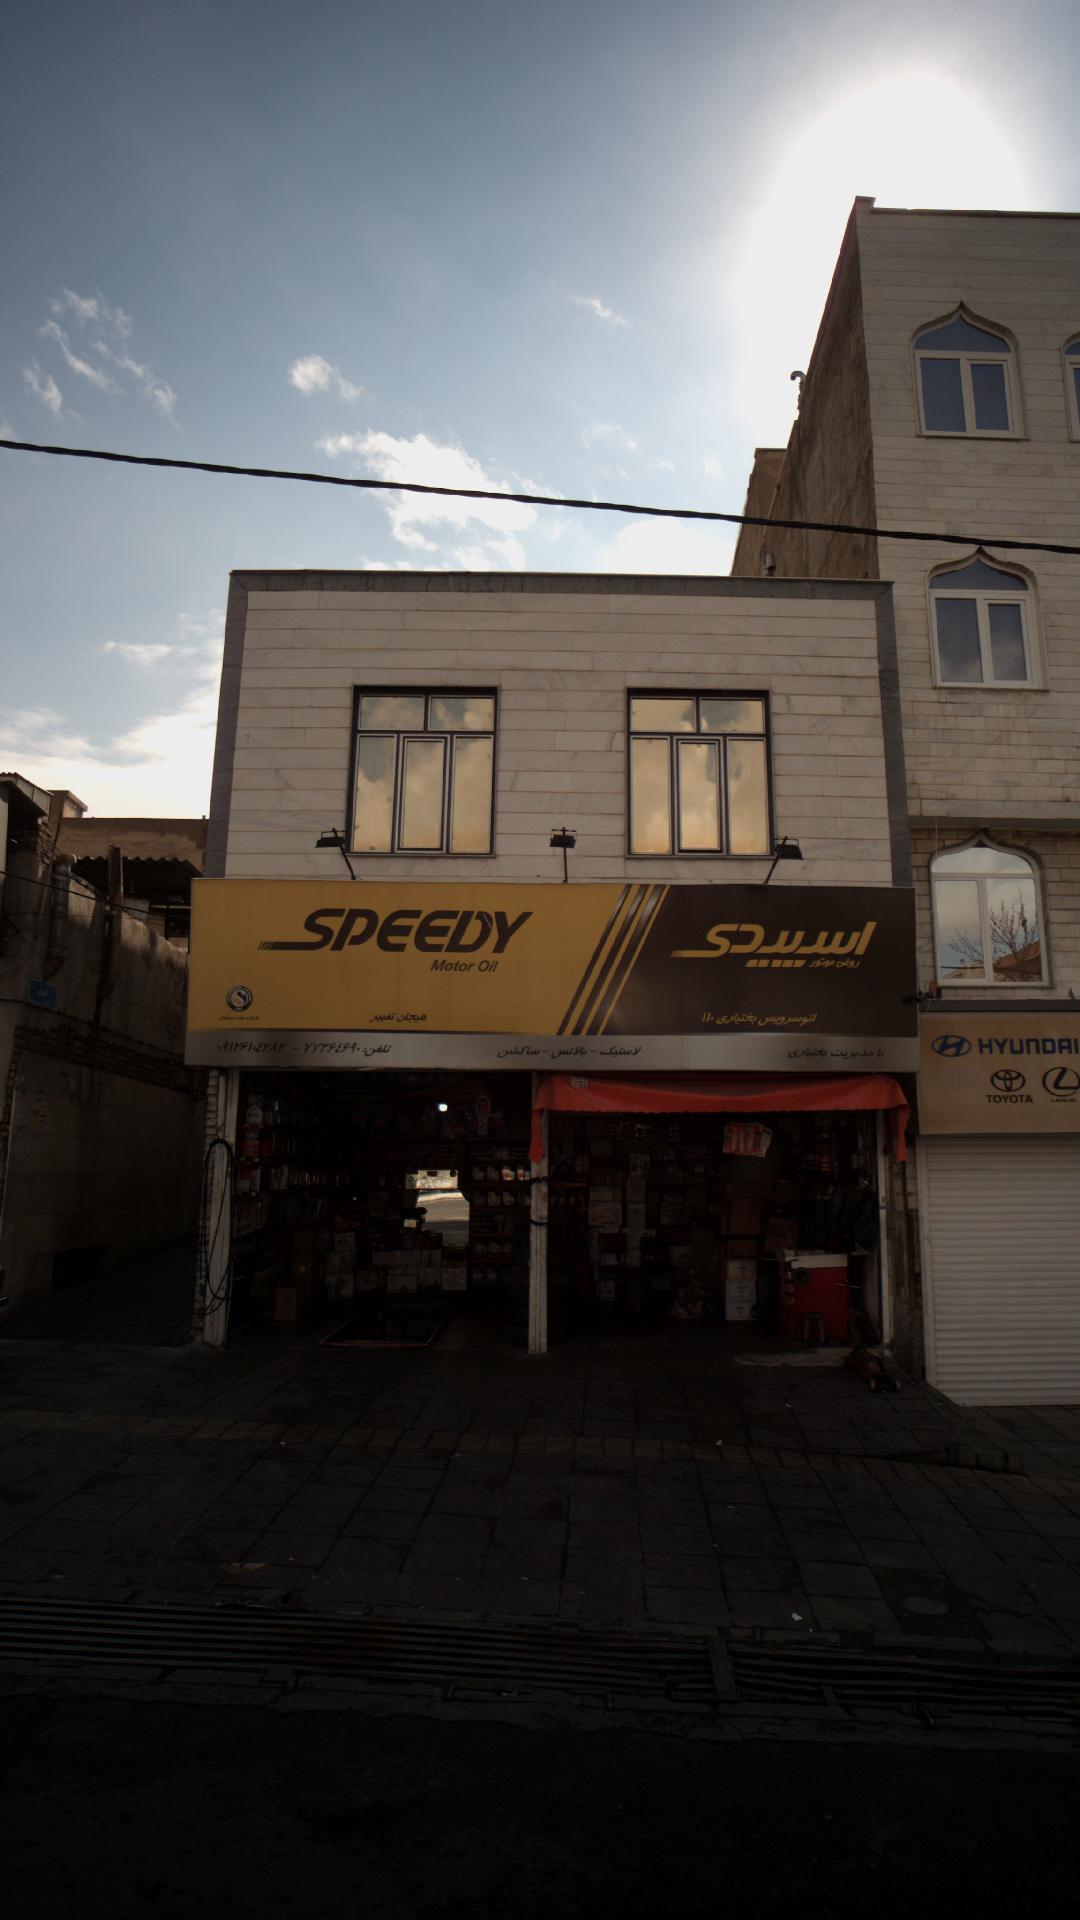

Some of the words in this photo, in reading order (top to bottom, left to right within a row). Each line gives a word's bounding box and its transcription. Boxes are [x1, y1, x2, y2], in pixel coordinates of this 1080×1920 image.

[258, 907, 534, 954] SPEEDY
[671, 920, 878, 968] اسپیدی
[430, 959, 475, 972] Motor
[478, 959, 499, 972] Oil
[808, 957, 835, 969] موتور
[835, 958, 861, 968] روغن
[716, 1012, 758, 1025] بختیاری
[551, 1045, 588, 1059] بالانس
[599, 1046, 642, 1058] لاستیک
[977, 1038, 1079, 1055] HYUNDAI
[787, 1047, 828, 1059] بختیاری
[830, 1048, 874, 1059] مدیریت
[986, 1094, 1034, 1104] TOYOTA
